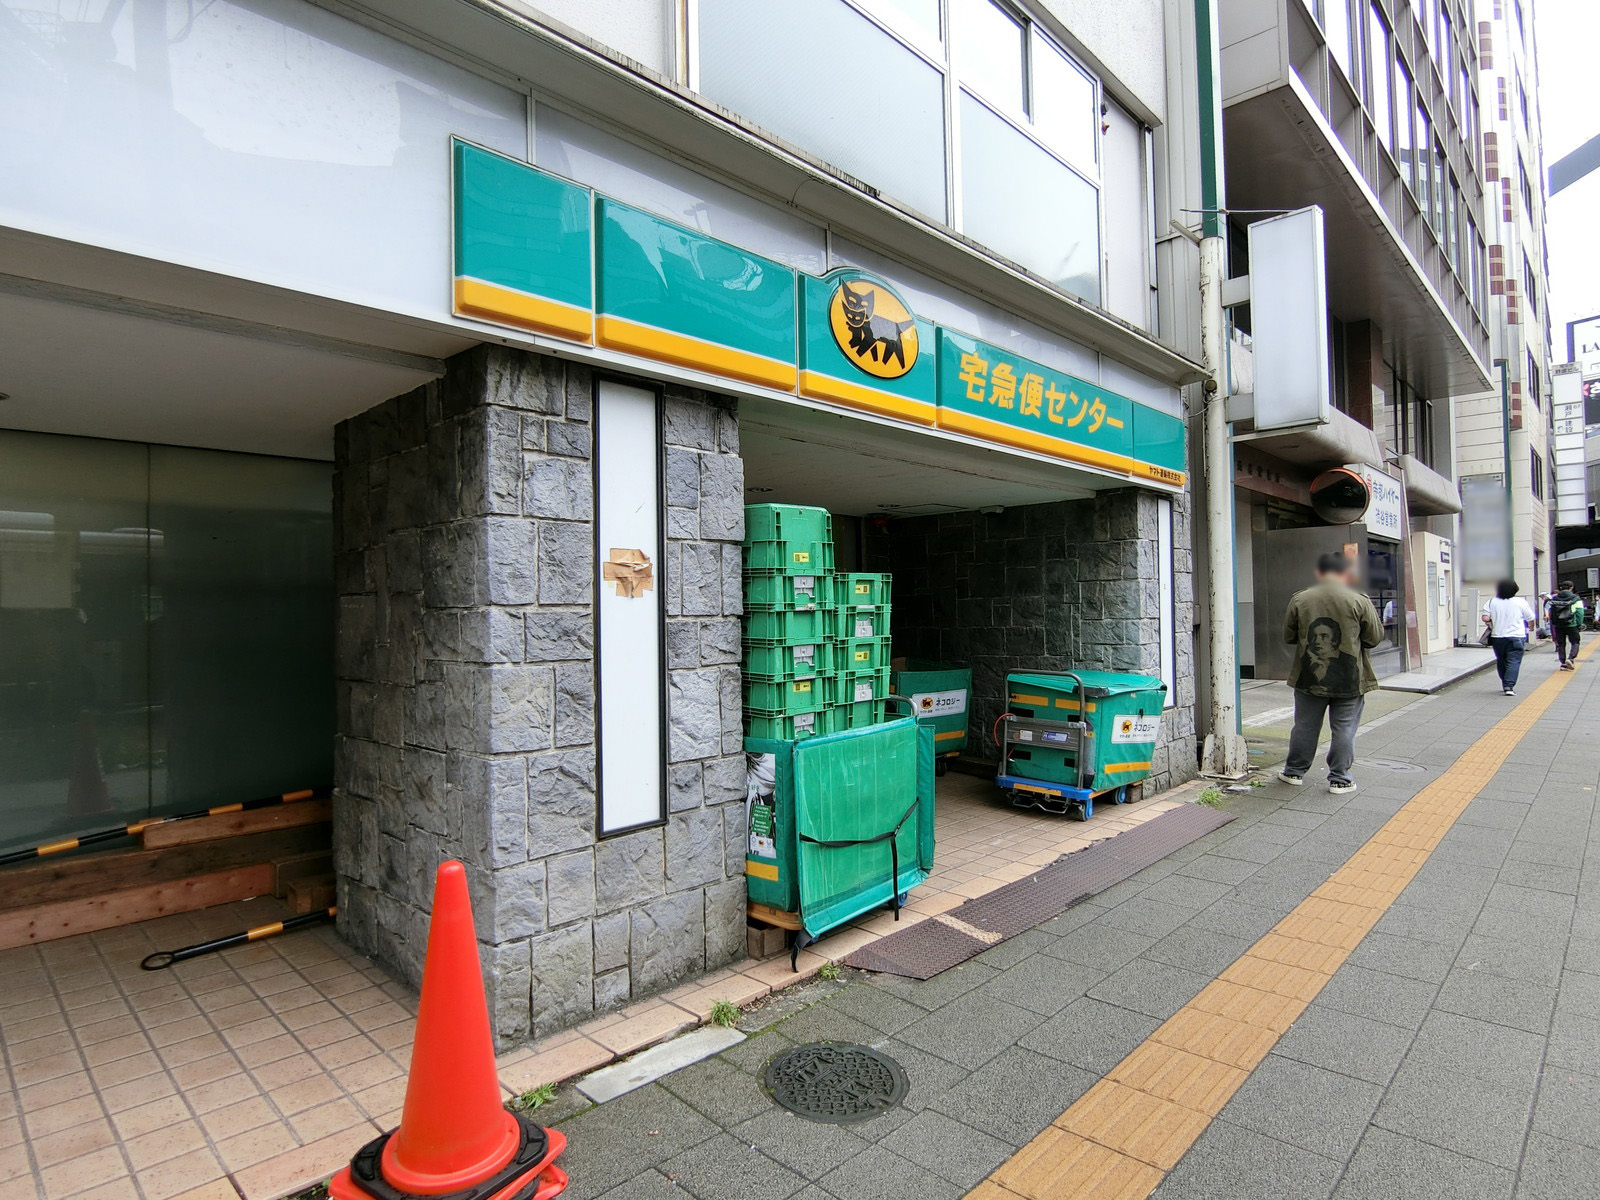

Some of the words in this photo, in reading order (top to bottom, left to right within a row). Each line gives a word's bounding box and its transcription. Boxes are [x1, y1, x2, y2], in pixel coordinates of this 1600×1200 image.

[959, 352, 1123, 433] 宅急便センター
[935, 697, 961, 706] ネコロジー
[1133, 722, 1155, 732] ネコロジー
